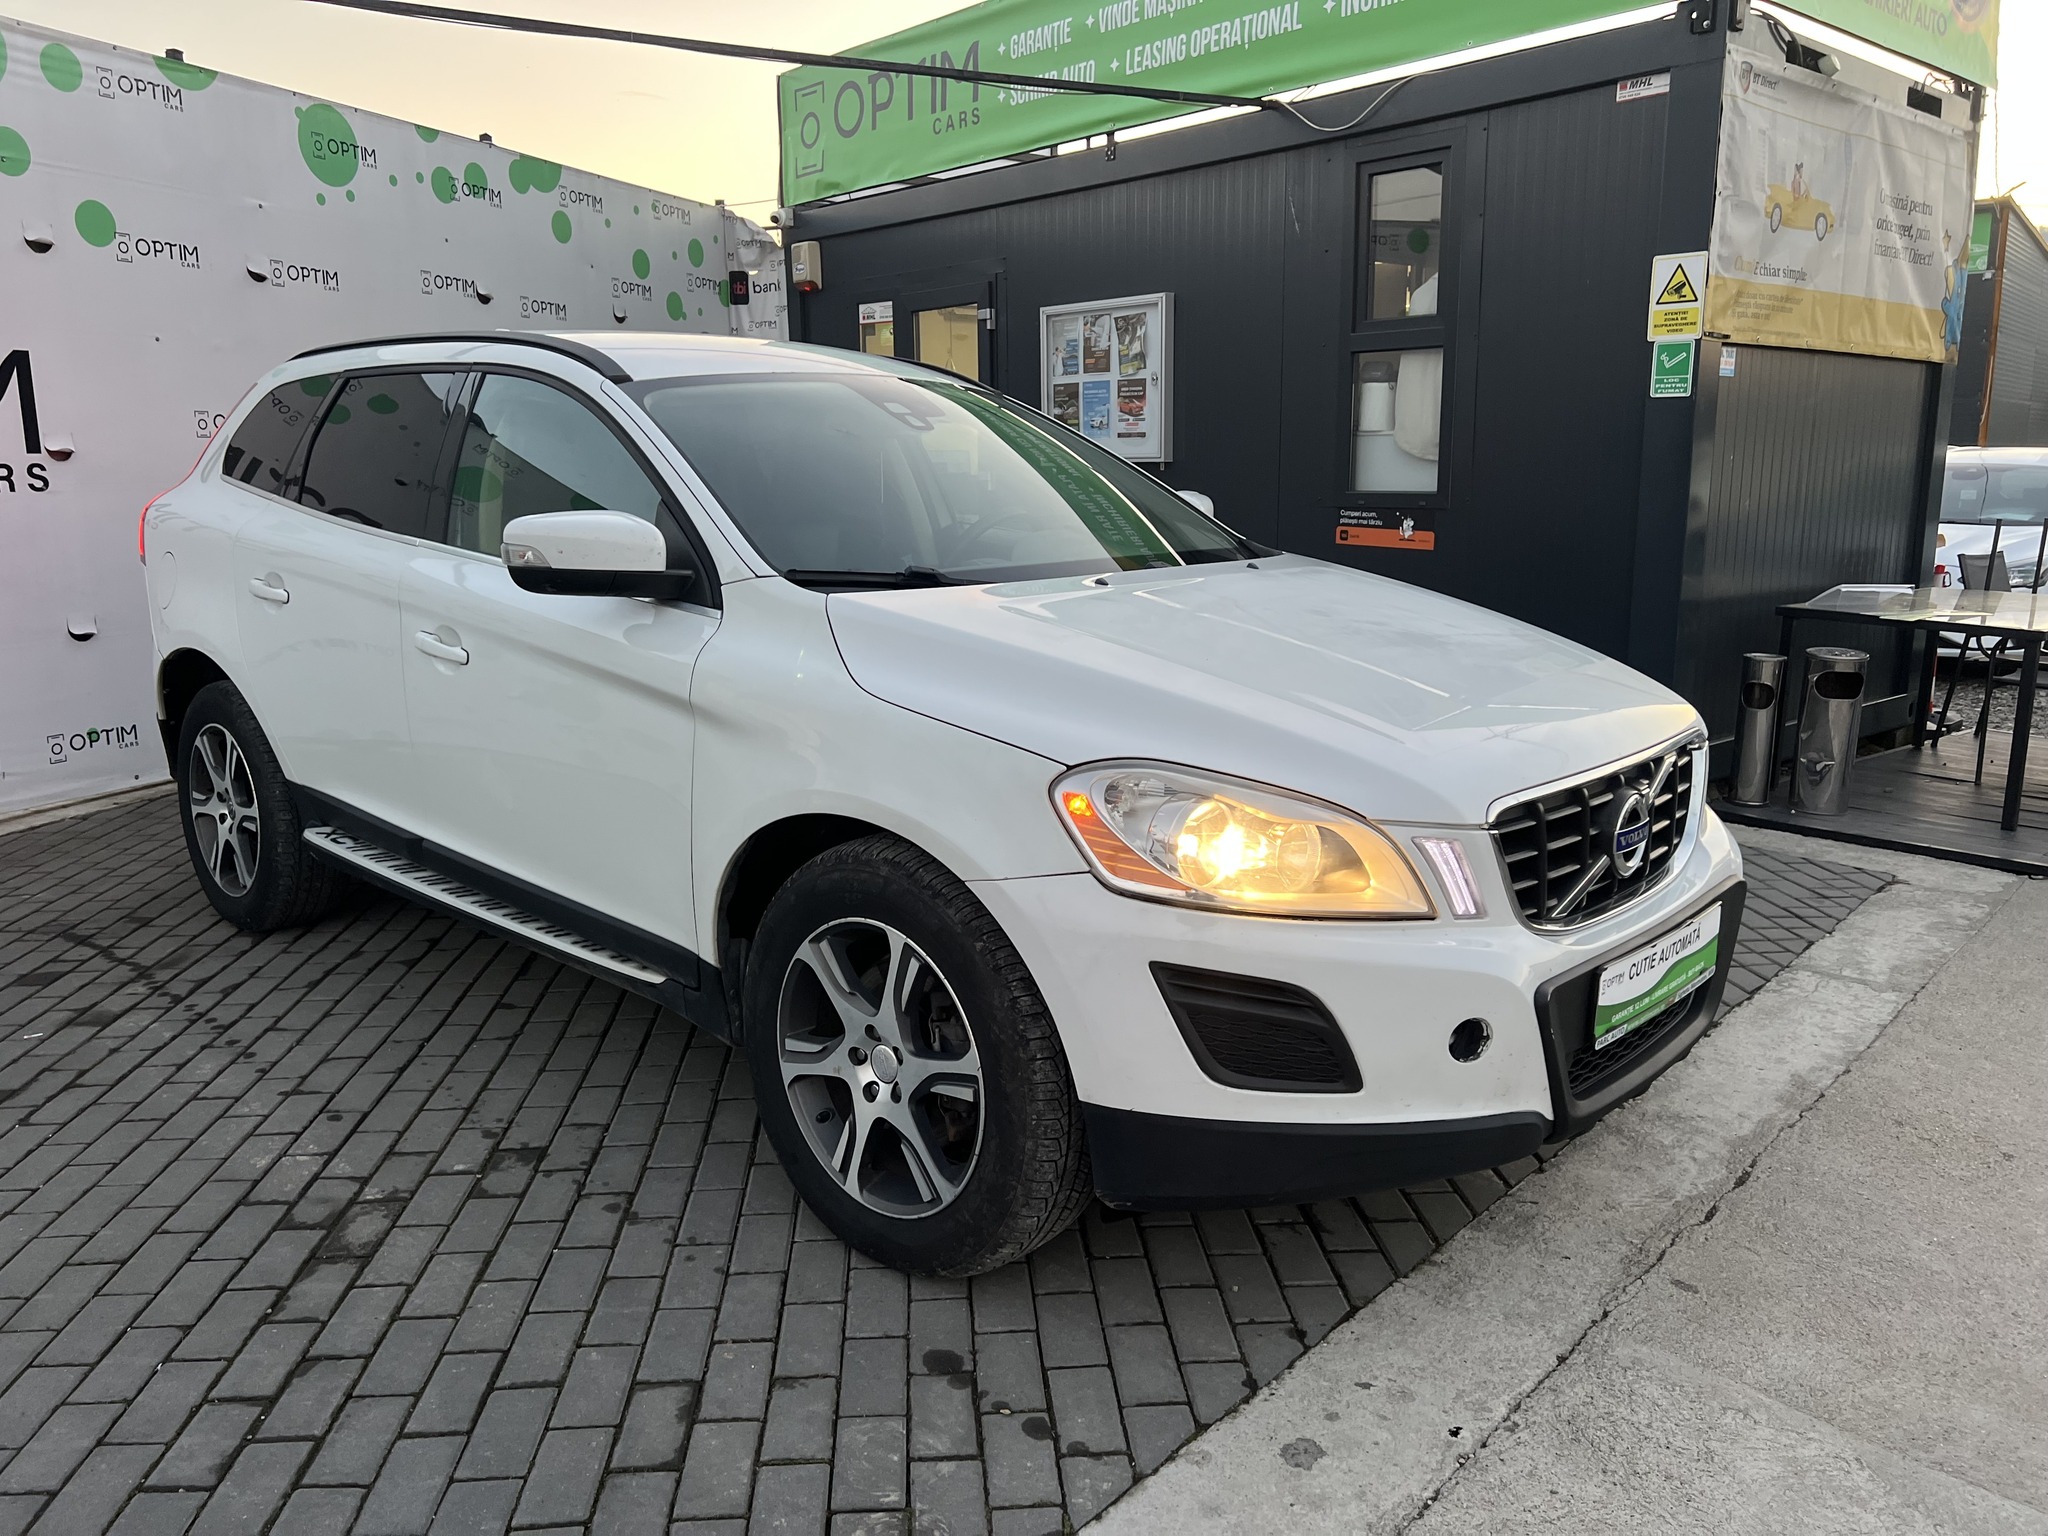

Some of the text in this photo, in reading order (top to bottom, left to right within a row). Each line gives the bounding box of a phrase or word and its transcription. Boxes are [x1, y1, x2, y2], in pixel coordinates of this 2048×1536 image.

[1098, 0, 1141, 33] VINDE
[1914, 5, 1948, 36] AUTO
[1010, 17, 1073, 59] GARANȚIE
[1125, 1, 1302, 75] LEASING OPERAȚIONAL
[117, 74, 183, 106] OPTIM
[834, 40, 981, 138] OPTIM
[1629, 77, 1653, 89] MHL
[164, 103, 184, 112] CARS
[933, 107, 981, 135] CARS
[327, 138, 377, 164] OPTIM
[362, 161, 378, 170] CARS
[462, 182, 502, 204] OPTIM
[569, 190, 603, 209] OPTIM
[662, 204, 691, 221] OPTIM
[1908, 200, 1932, 216] pentru
[135, 238, 199, 263] OPTIM
[1908, 247, 1934, 266] Direct!
[287, 265, 339, 286] OPTIM
[1759, 262, 1781, 277] chiar
[434, 274, 475, 293] OPTIM
[621, 281, 652, 297] OPTIM
[695, 277, 721, 291] OPTIM
[732, 282, 746, 294] tbi
[531, 300, 567, 316] OPTIM
[755, 320, 777, 329] OPTIM
[1340, 509, 1361, 517] Cumperi
[70, 724, 138, 751] OPTIM
[119, 741, 139, 749] CARS
[1607, 922, 1702, 988] OPTIM CUTIE AUTOMATĂ
[1597, 1034, 1611, 1048] PARC
